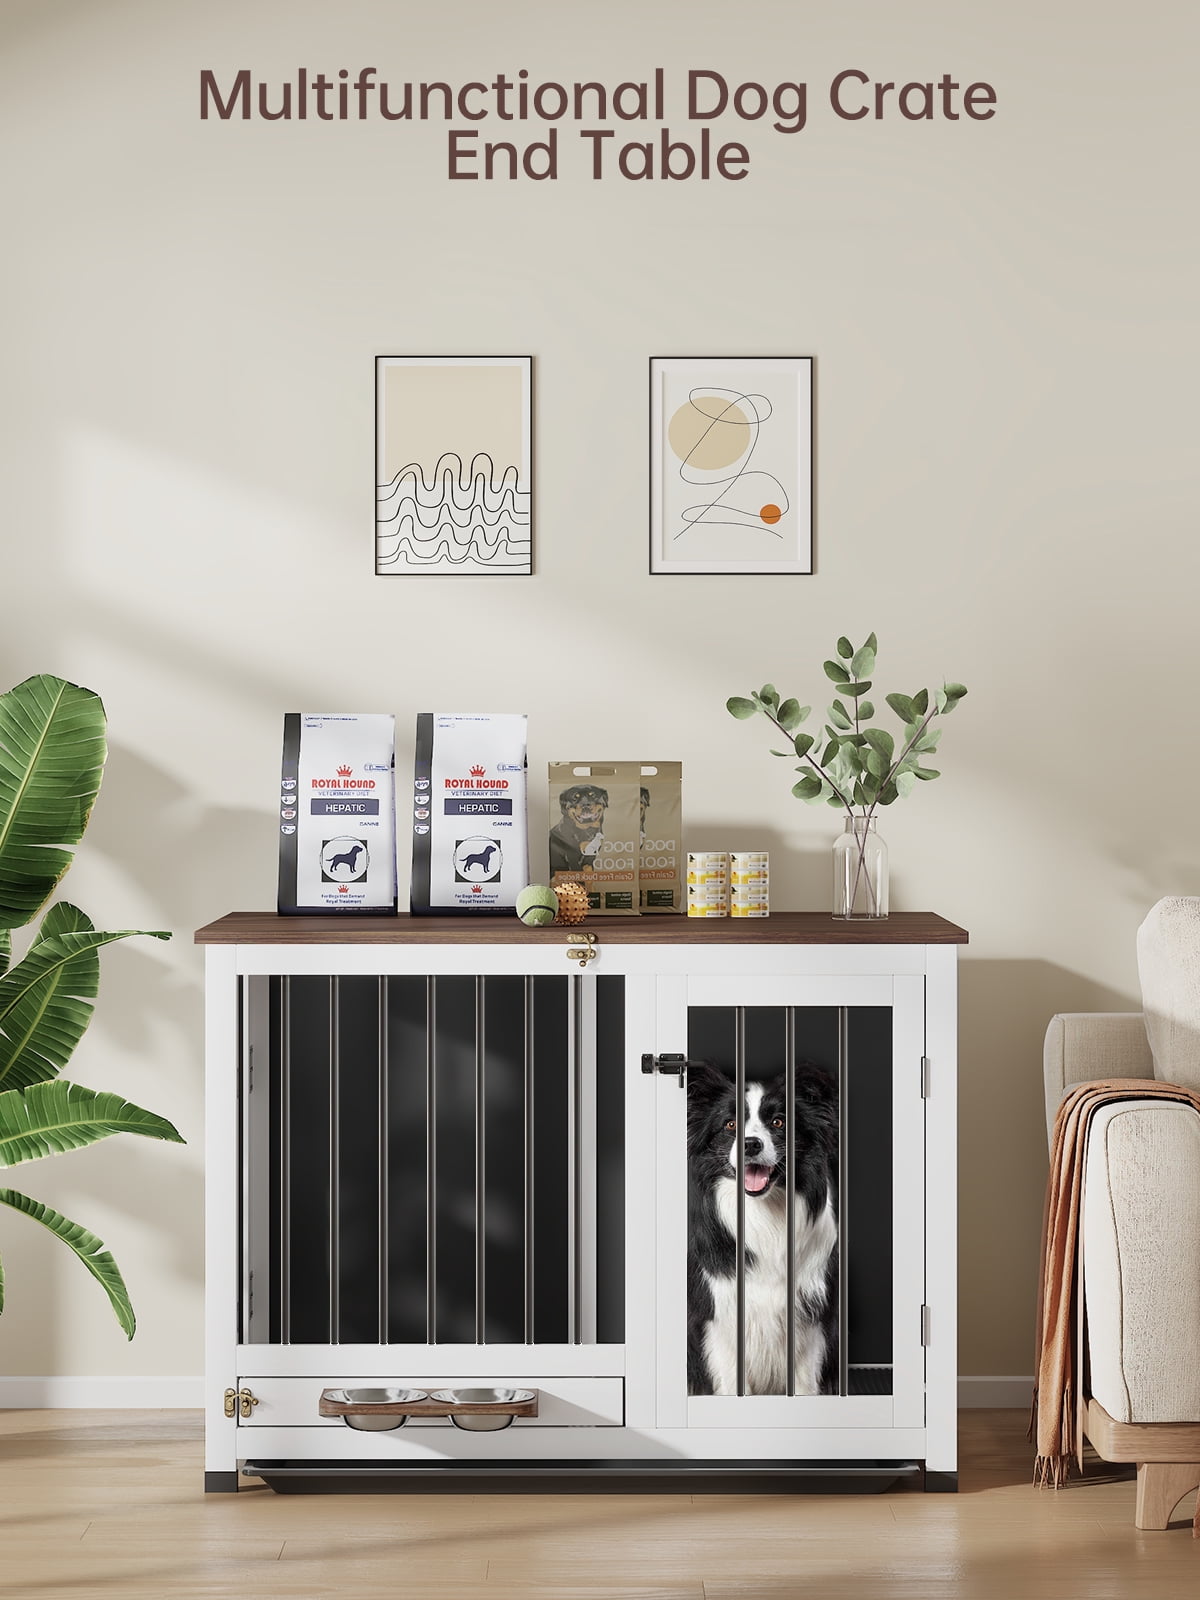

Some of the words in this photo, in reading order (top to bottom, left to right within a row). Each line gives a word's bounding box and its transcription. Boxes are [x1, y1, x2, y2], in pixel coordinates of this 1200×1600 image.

[311, 779, 341, 789] ROYAL
[343, 779, 376, 789] HOUND
[444, 779, 474, 789] ROYAL
[476, 779, 509, 789] HOUND
[325, 804, 366, 812] HEPATIC
[459, 804, 499, 812] HEPATIC
